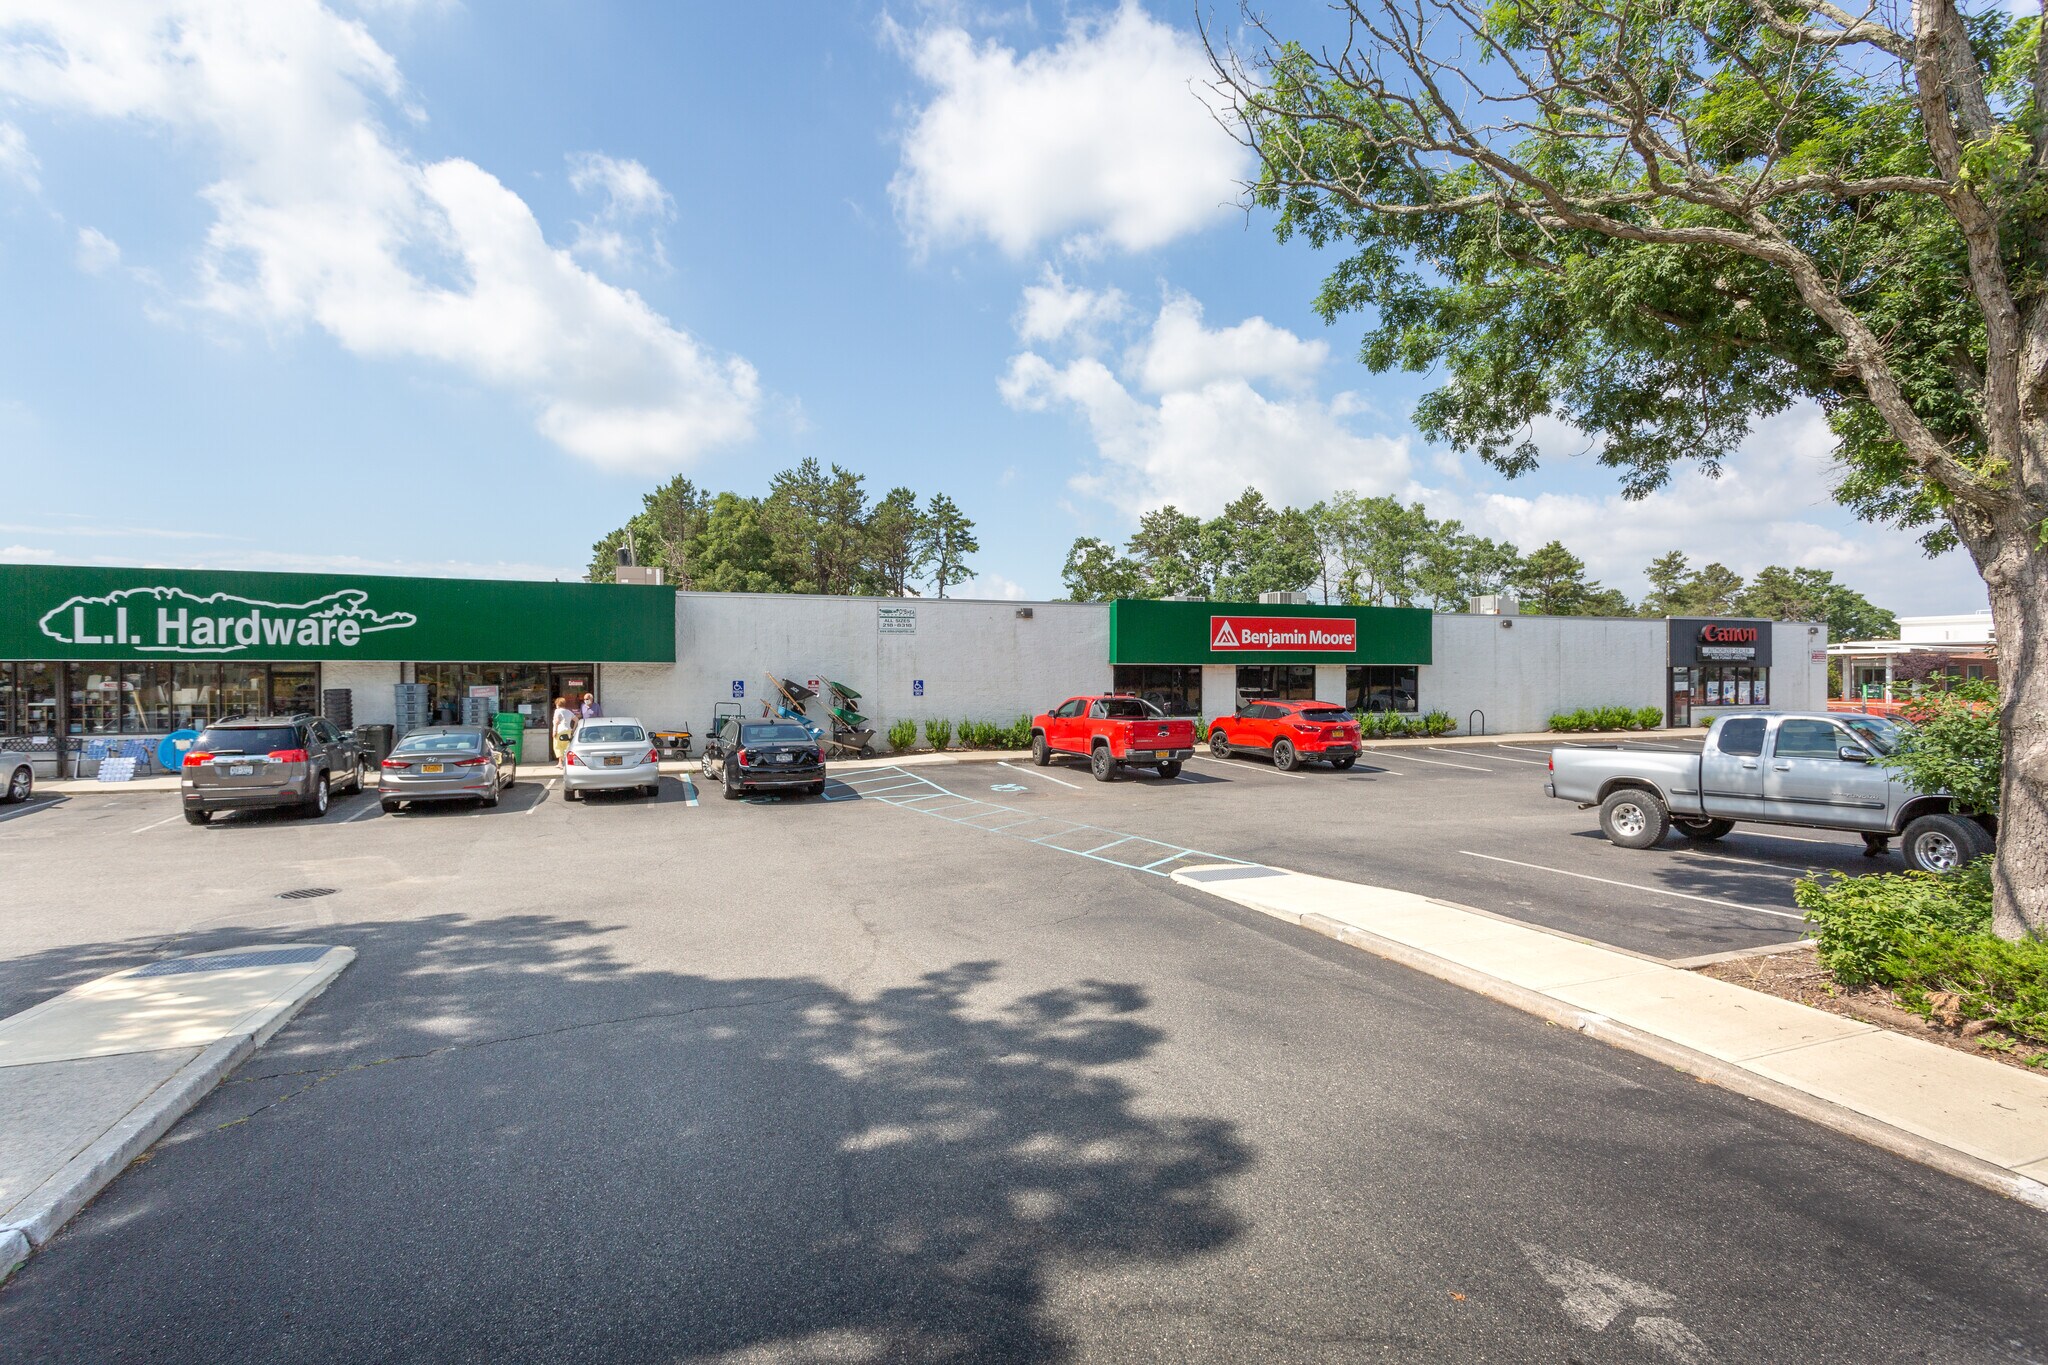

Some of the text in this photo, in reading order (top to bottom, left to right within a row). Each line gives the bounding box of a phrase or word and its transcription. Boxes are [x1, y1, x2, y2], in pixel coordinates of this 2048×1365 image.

[74, 606, 361, 647] L.I. Hardware
[1704, 624, 1758, 642] Canon
[1241, 628, 1352, 648] Benjamin Moore
